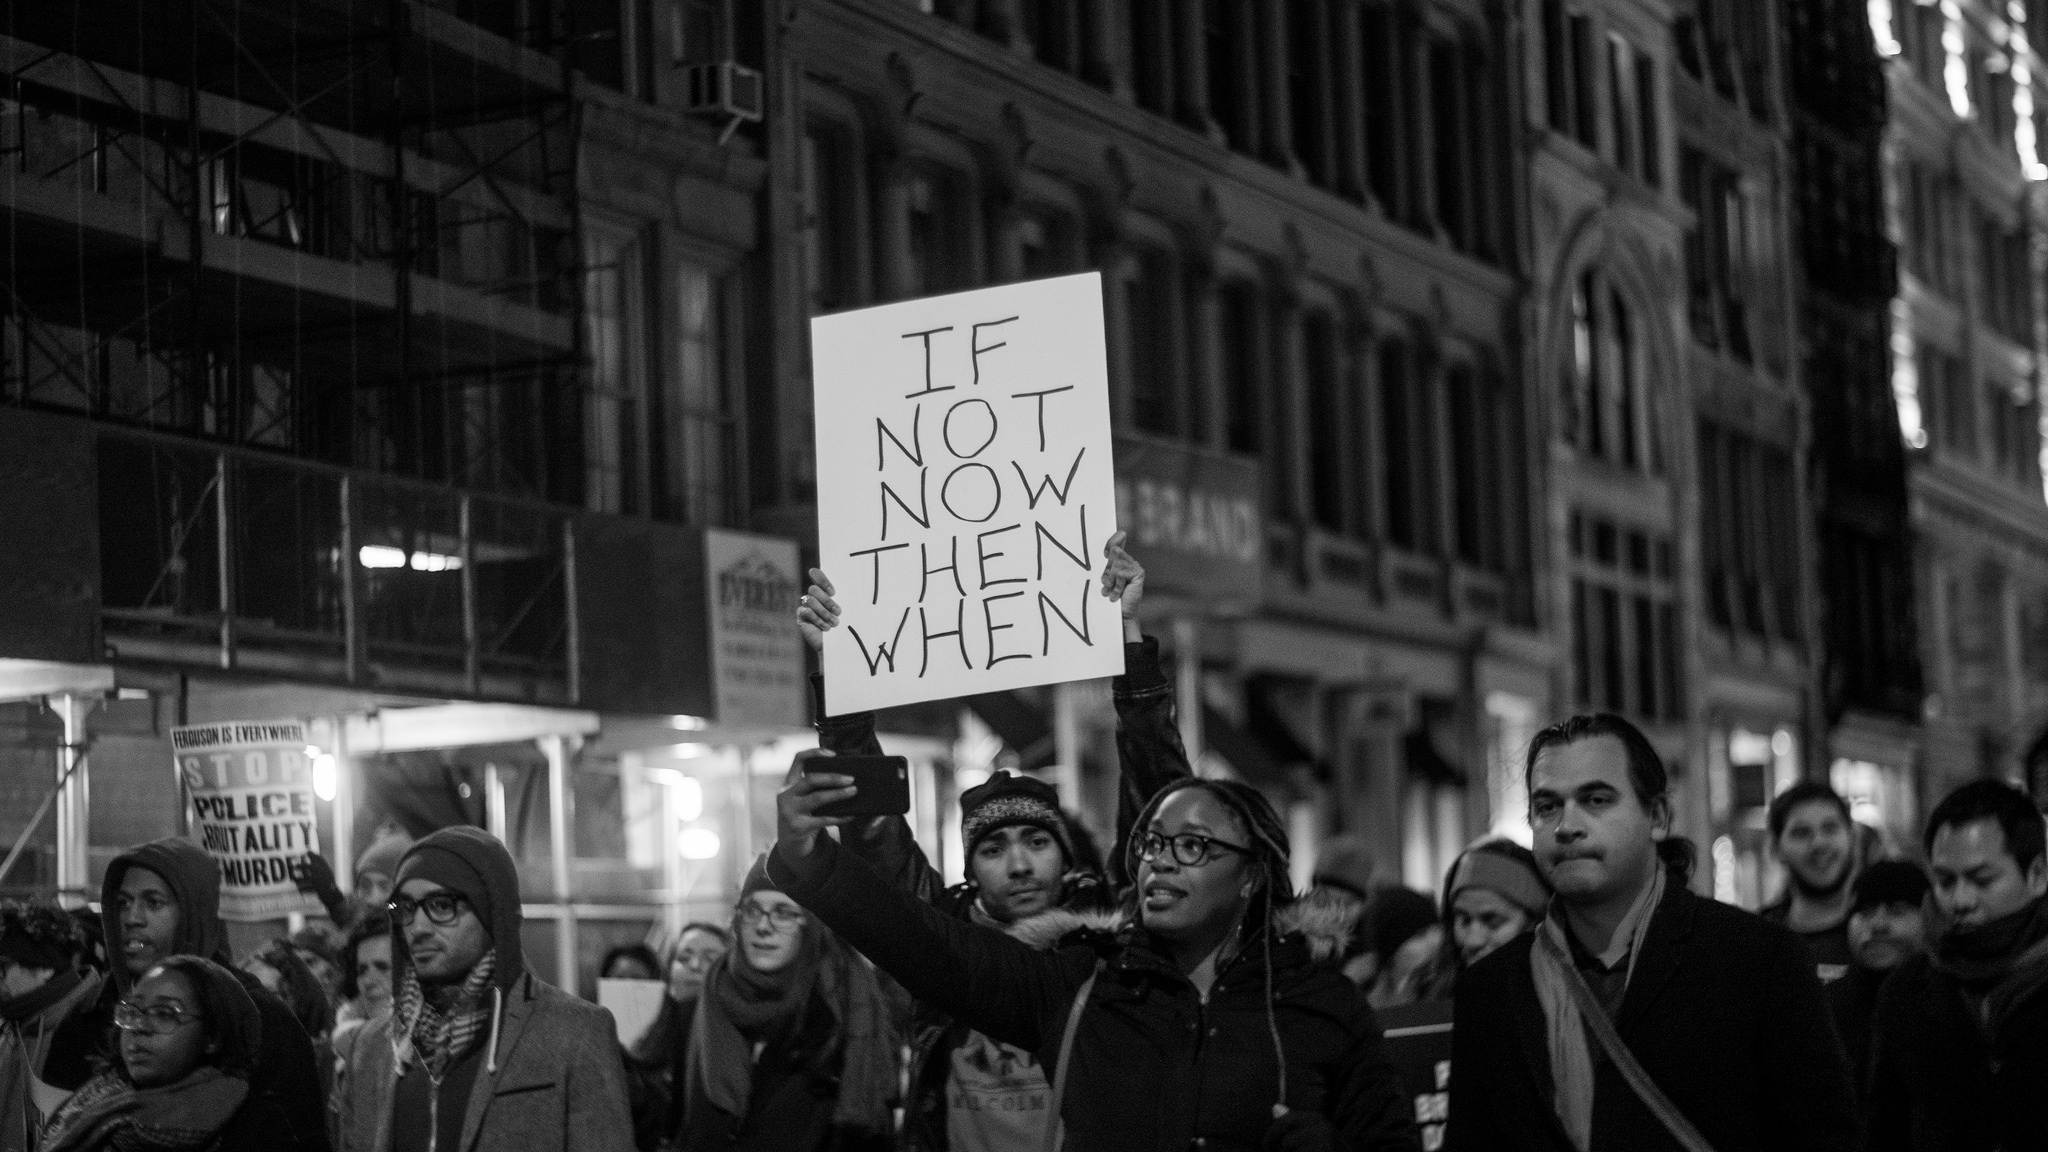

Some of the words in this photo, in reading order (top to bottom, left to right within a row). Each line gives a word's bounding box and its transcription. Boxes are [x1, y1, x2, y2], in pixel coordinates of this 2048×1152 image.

[901, 315, 1019, 399] IF
[876, 384, 1075, 472] NOT
[877, 446, 1086, 542] NOW
[848, 503, 1093, 606] THEN
[847, 578, 1095, 679] WHEN
[173, 728, 219, 750] FERGUSON
[222, 727, 232, 743] IS
[235, 725, 303, 743] EVERYWHERE
[184, 750, 303, 789] STOP
[194, 793, 309, 820] POLICE
[204, 822, 311, 853] BRUTALITY
